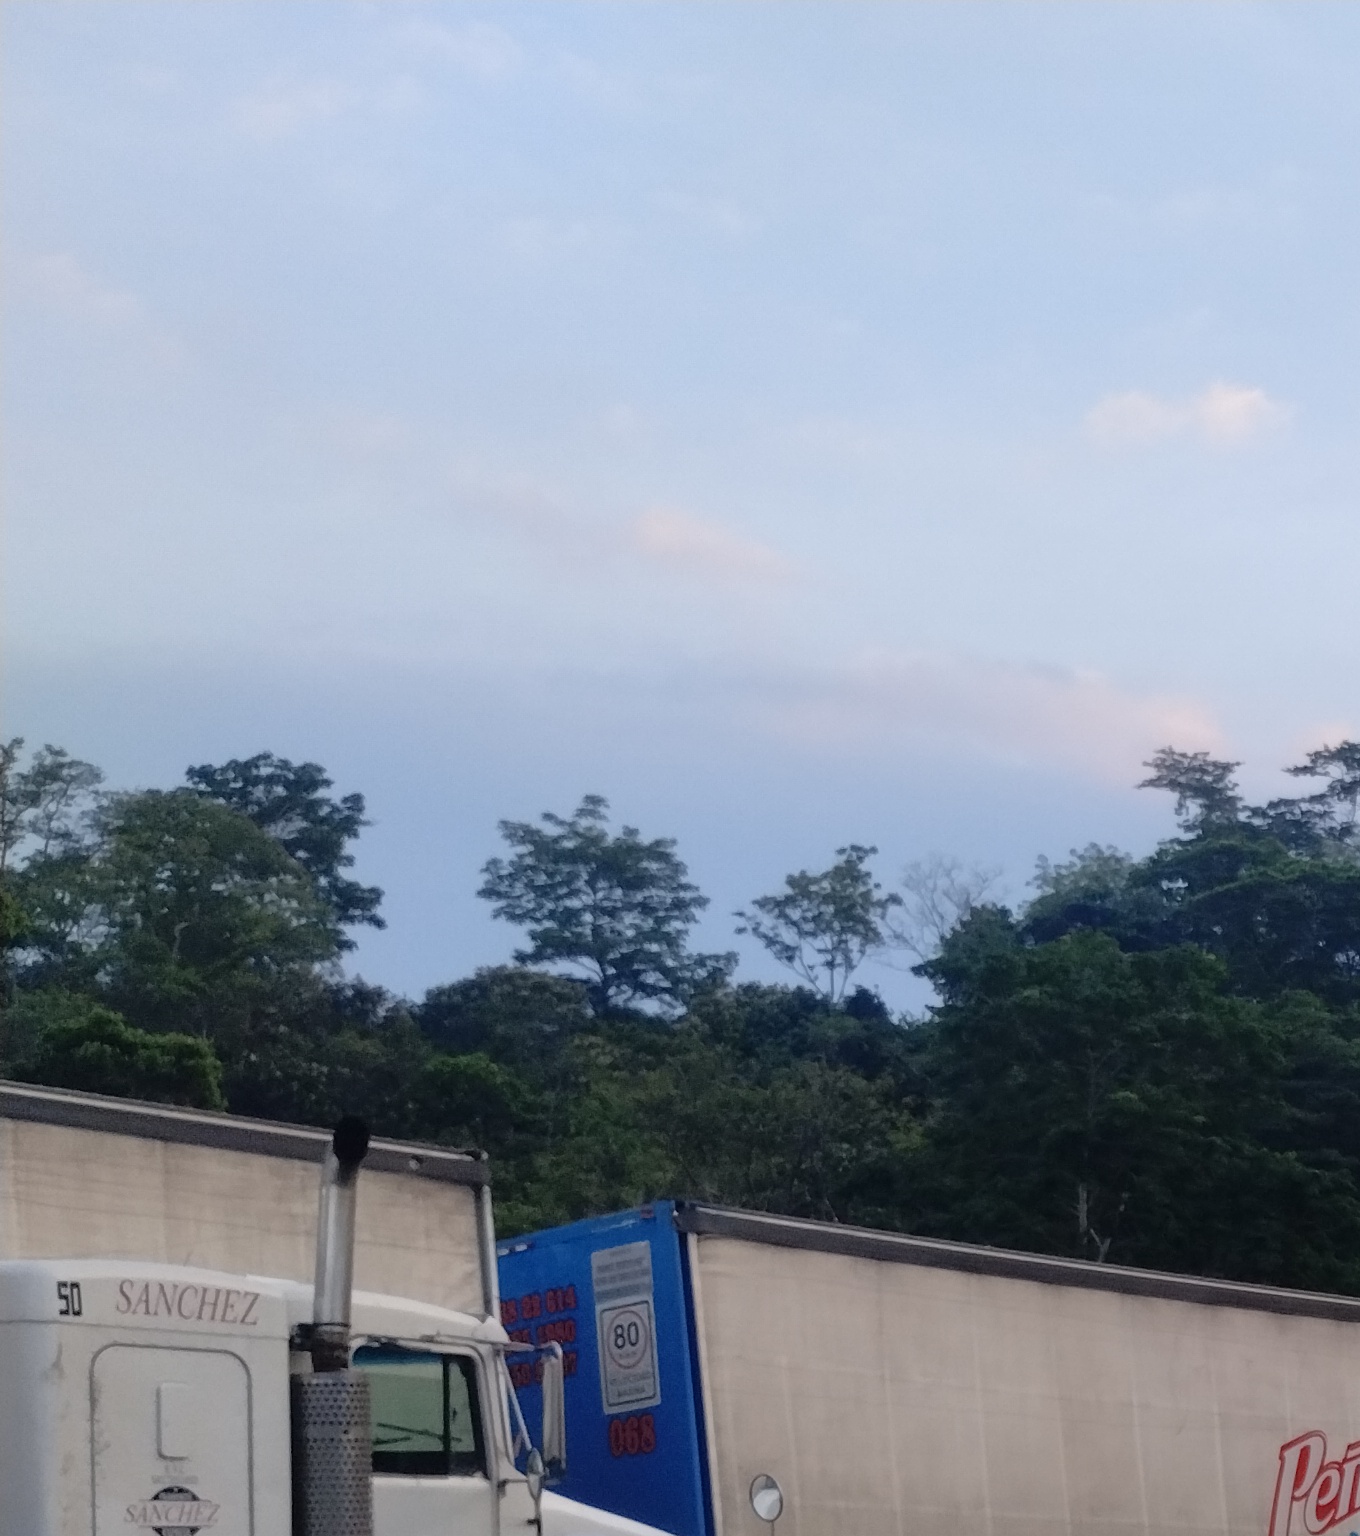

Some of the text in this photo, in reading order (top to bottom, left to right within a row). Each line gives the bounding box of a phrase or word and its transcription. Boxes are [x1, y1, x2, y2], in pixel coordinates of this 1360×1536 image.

[57, 1281, 82, 1316] 50
[116, 1279, 260, 1326] SANCHEZ
[614, 1322, 639, 1350] 80
[609, 1414, 656, 1458] 068
[123, 1503, 221, 1524] SANCHEZ
